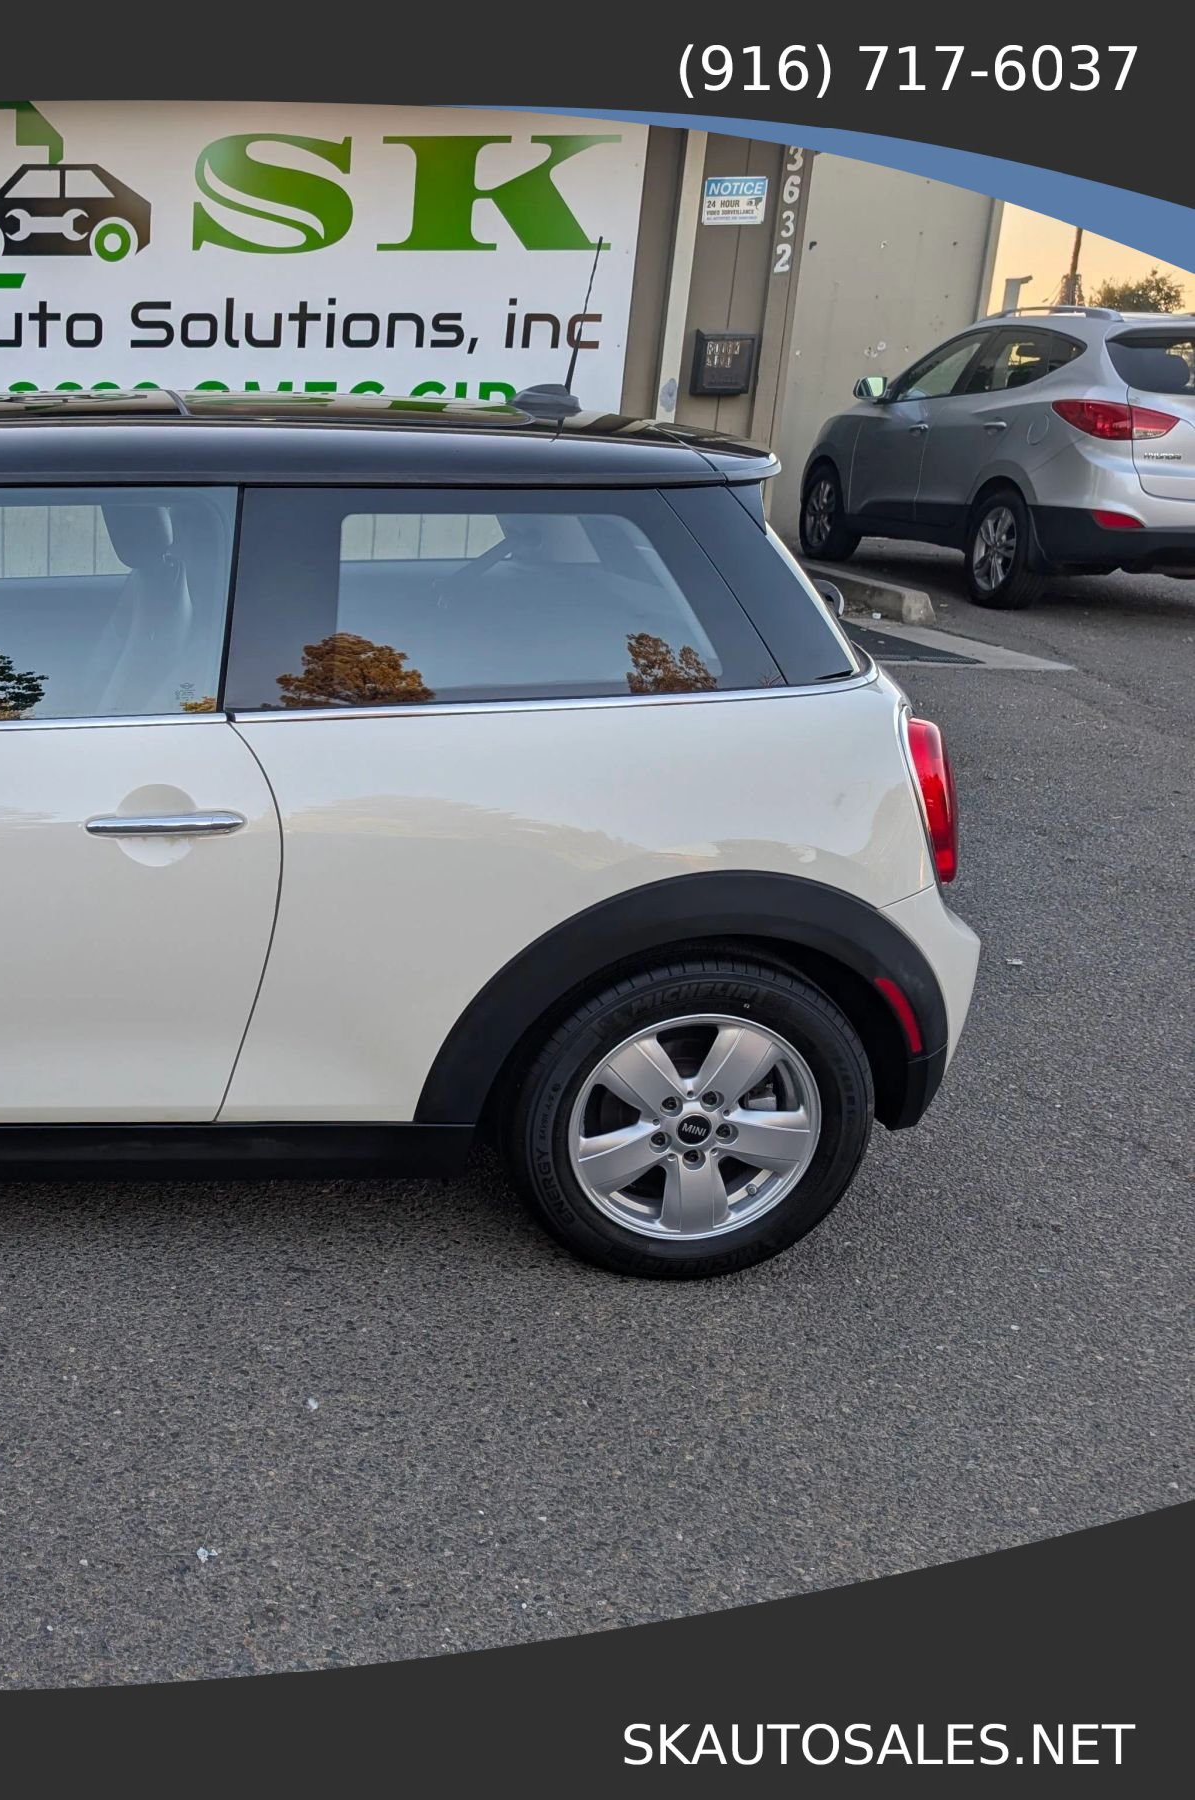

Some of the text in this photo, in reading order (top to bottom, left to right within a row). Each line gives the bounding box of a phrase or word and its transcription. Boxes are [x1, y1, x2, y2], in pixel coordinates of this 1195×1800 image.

[191, 132, 622, 254] SK
[708, 182, 765, 195] NOTICE
[707, 199, 740, 208] 24 HOUR
[130, 297, 479, 355] Solutions,
[505, 298, 603, 349] inc
[682, 1122, 707, 1137] MINI
